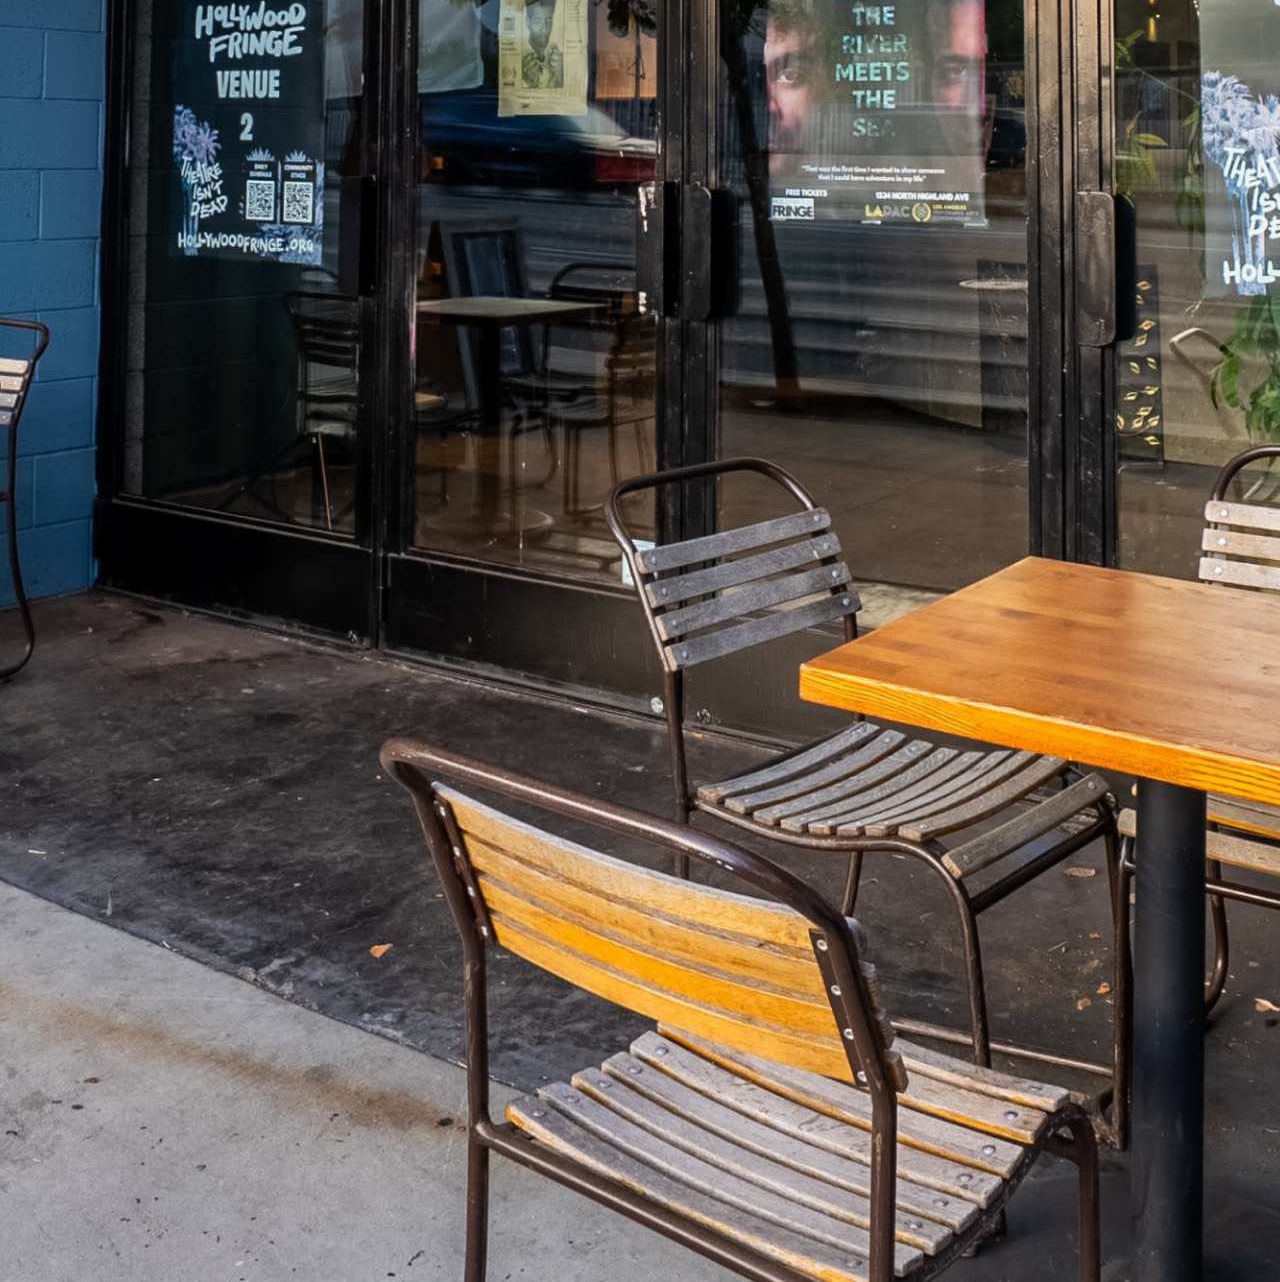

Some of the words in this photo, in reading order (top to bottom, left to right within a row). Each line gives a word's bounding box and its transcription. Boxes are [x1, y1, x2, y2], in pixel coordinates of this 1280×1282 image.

[195, 0, 306, 40] HOLLYWOOD
[852, 4, 896, 26] THE
[209, 26, 306, 63] FRINGE
[842, 33, 908, 54] RIVER
[835, 61, 910, 82] MEETS
[216, 69, 280, 99] VENUE
[852, 89, 896, 110] THE
[240, 112, 254, 141] 2
[852, 118, 896, 138] SEA
[181, 155, 222, 184] THEATRE
[192, 181, 223, 201] ISN'T
[785, 188, 800, 196] FREE
[801, 189, 828, 197] TICKETS
[892, 192, 916, 200] NORTH
[918, 192, 953, 201] HIGHLAND
[954, 193, 969, 201] AVE
[191, 196, 228, 220] DEAD
[772, 205, 813, 218] FRINGE
[177, 231, 314, 253] HOLLYWOODFRINGE.ORG
